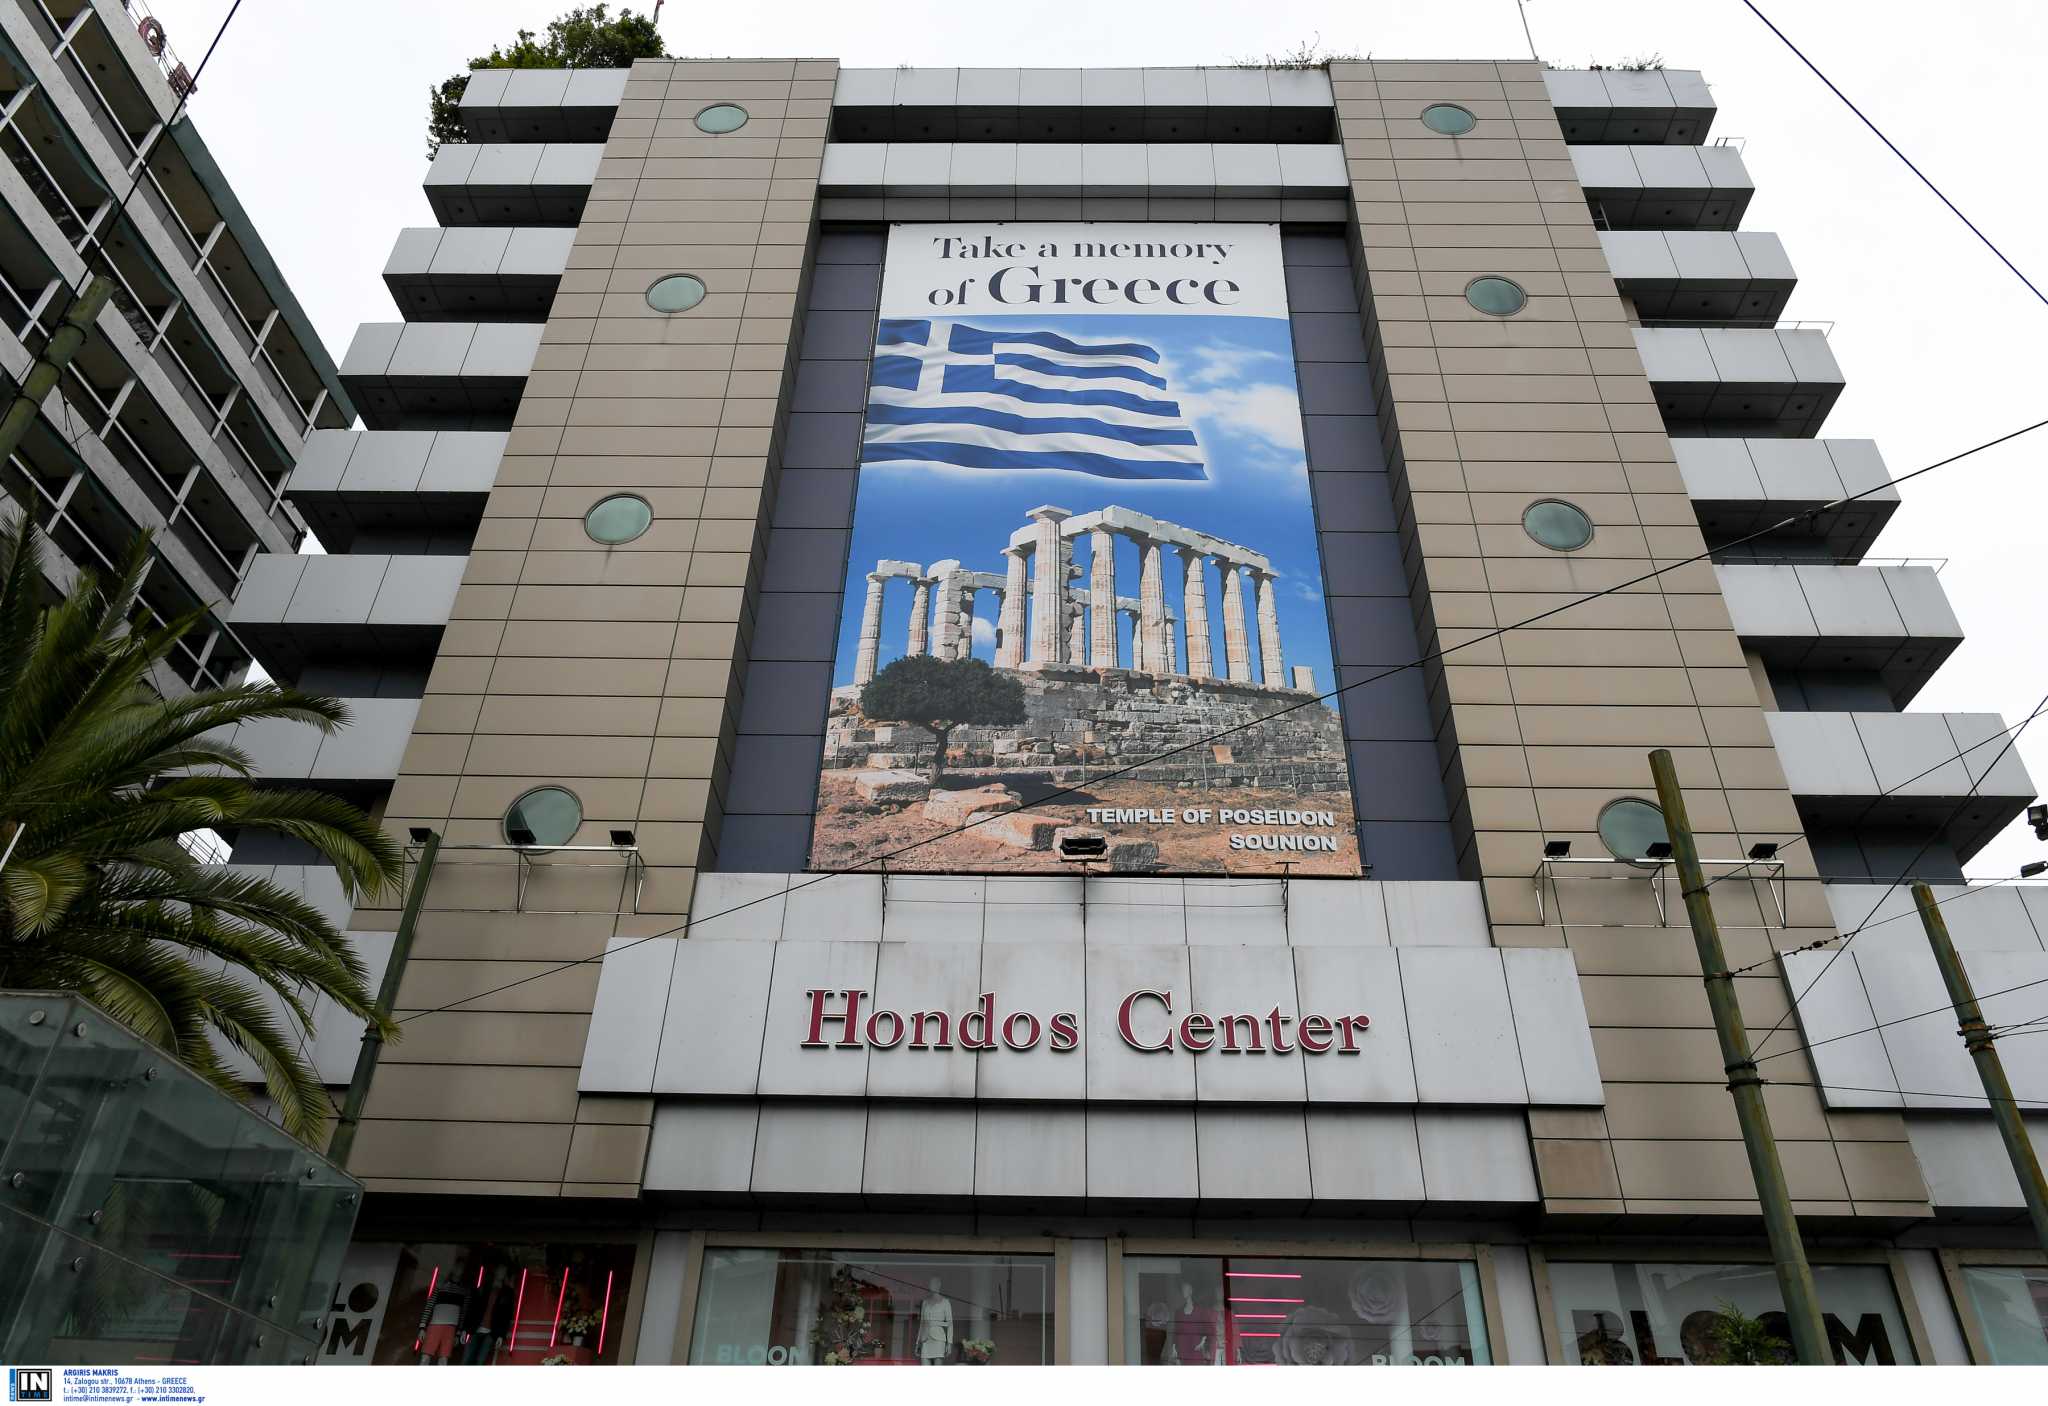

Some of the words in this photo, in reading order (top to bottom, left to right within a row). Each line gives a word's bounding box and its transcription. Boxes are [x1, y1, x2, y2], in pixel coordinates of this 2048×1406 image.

[932, 236, 1027, 260] Take
[1037, 243, 1059, 260] a
[1071, 241, 1236, 265] memory
[927, 278, 976, 306] of
[987, 264, 1241, 307] Greece
[1086, 808, 1176, 824] TEMPLE
[1182, 808, 1212, 825] OF
[1219, 808, 1336, 827] POSEIDON
[1229, 834, 1338, 852] SOUNION
[800, 988, 1080, 1051] Hondos
[1116, 988, 1371, 1056] Center
